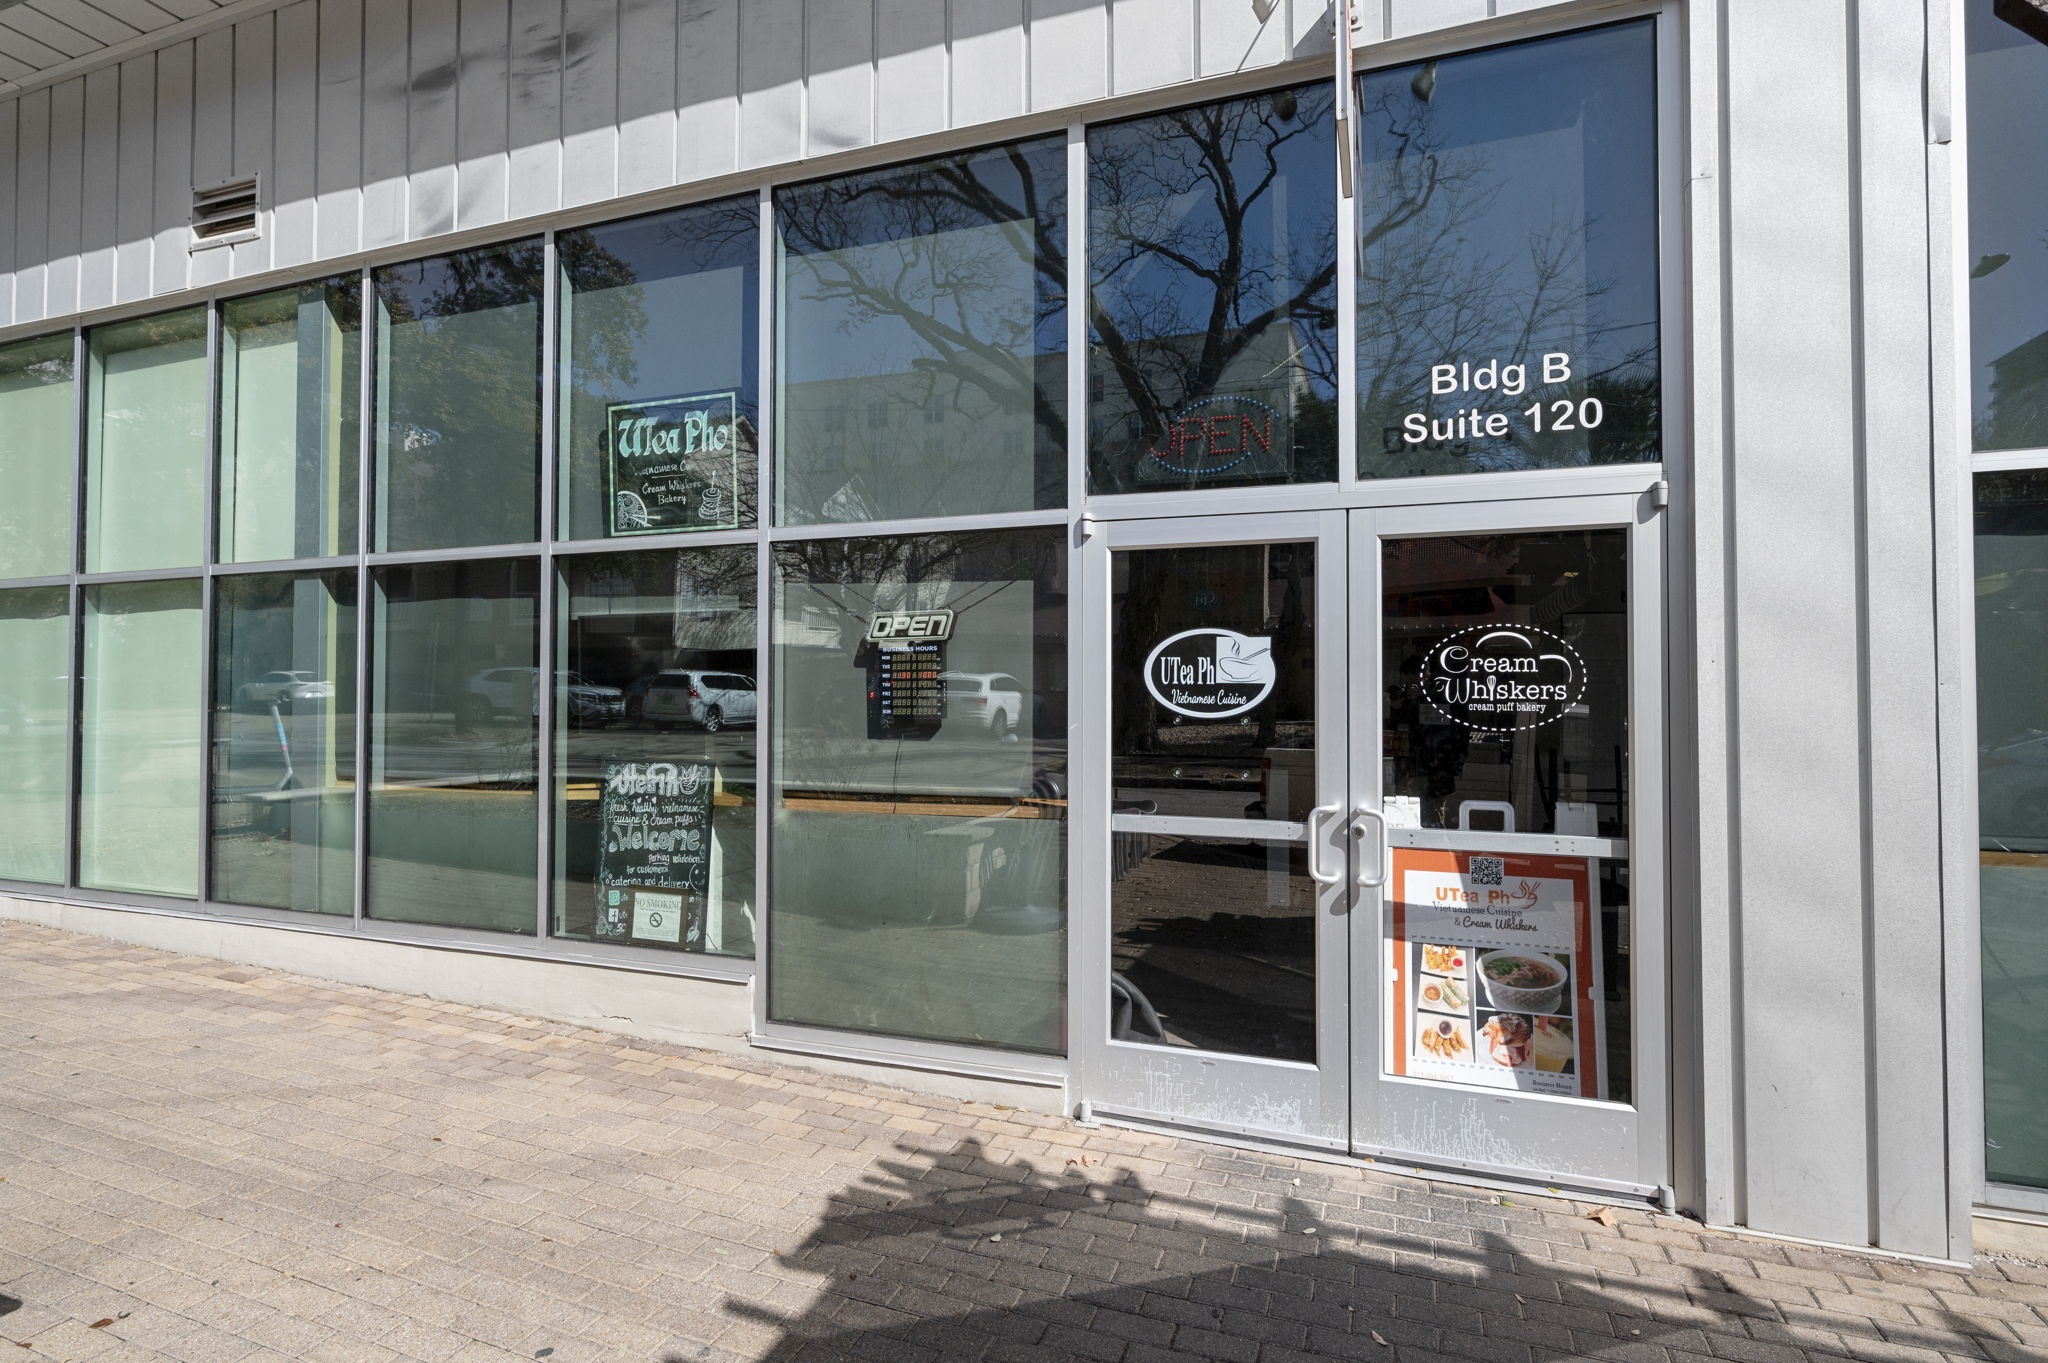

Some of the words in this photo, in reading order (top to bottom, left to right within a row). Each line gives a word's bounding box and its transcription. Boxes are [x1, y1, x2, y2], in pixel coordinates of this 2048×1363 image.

[1431, 359, 1525, 395] Bldg
[1543, 352, 1571, 383] B
[1403, 408, 1508, 443] Suite
[1524, 397, 1603, 432] 120
[684, 409, 728, 455] Pho
[641, 483, 667, 495] Cream
[668, 480, 701, 492] Whiskers
[657, 494, 687, 505] Bakery
[872, 615, 947, 637] OPEN
[1440, 645, 1538, 673] Cream
[1160, 656, 1194, 685] UTea
[1171, 688, 1216, 704] Vietnamese
[1217, 689, 1247, 705] Cuisine
[1434, 675, 1568, 704] Whiskers
[1468, 703, 1495, 711] cream
[1496, 702, 1514, 713] puff
[1516, 702, 1546, 714] bakery
[632, 799, 658, 814] healthy
[612, 825, 700, 851] Welcome
[626, 865, 635, 875] for
[636, 865, 669, 874] customers
[644, 878, 656, 886] and
[657, 876, 690, 889] delivery
[635, 897, 645, 907] NO
[1436, 886, 1479, 903] UTea
[1432, 900, 1485, 915] Vietnamese
[1487, 904, 1522, 917] Cuisine
[1454, 917, 1461, 927] &
[1462, 915, 1493, 929] Cream
[1495, 917, 1538, 932] Whiskers
